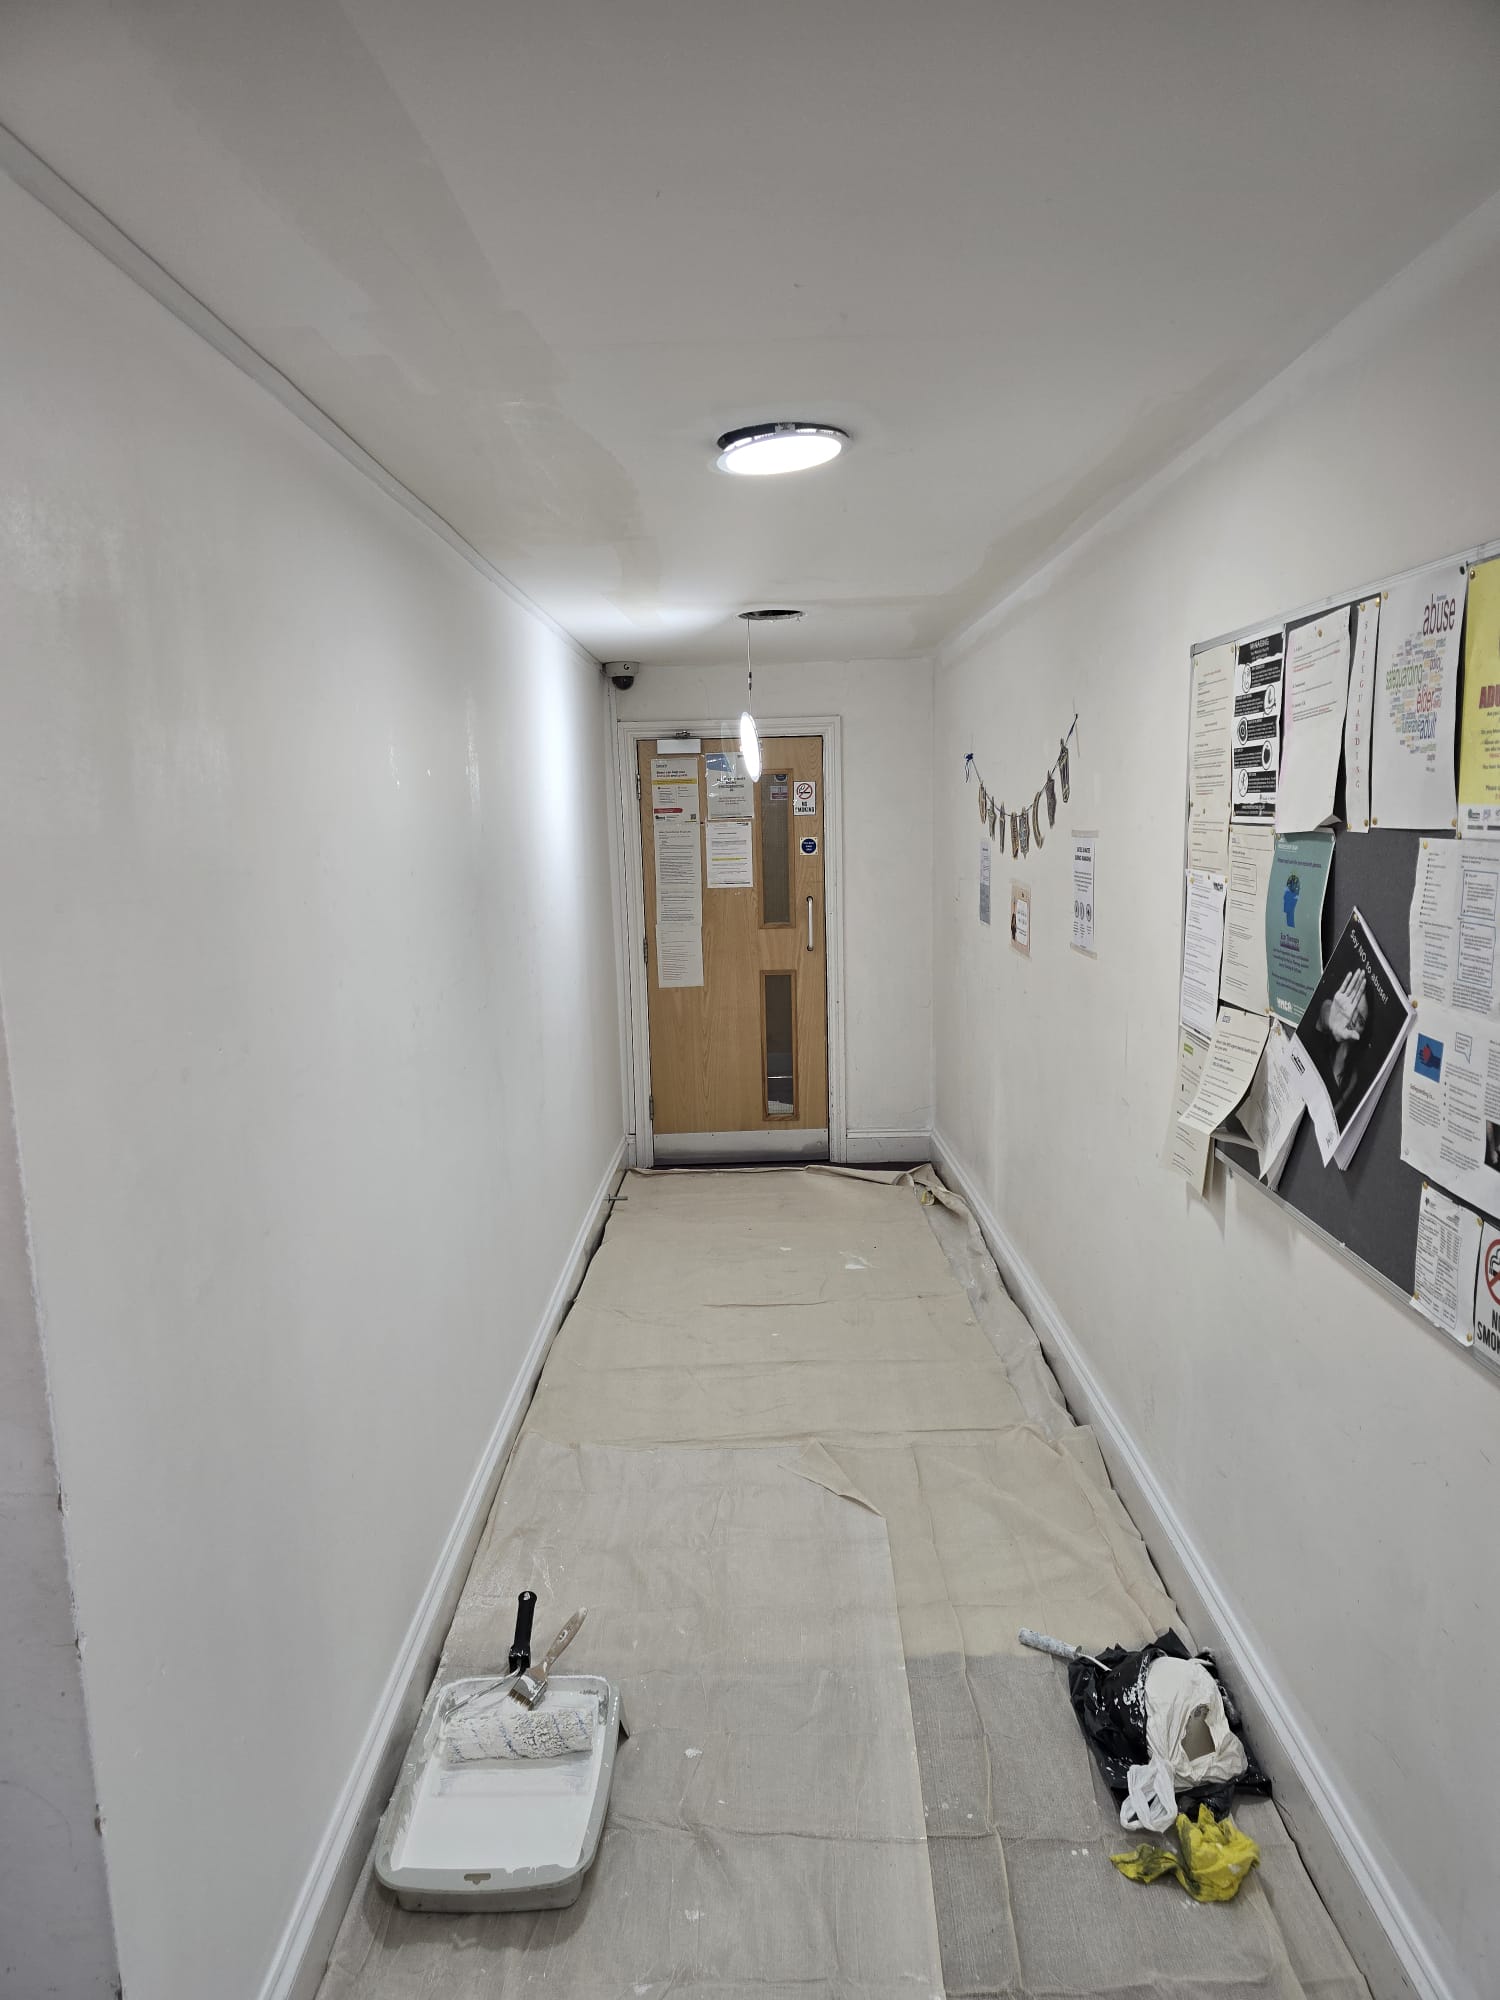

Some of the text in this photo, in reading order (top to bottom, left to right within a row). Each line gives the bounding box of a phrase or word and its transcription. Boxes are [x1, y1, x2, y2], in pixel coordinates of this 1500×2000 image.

[1423, 593, 1456, 636] abuse
[1386, 662, 1423, 695] safeguarding
[1416, 687, 1435, 713] elder
[1419, 711, 1437, 740] adult
[1350, 929, 1389, 1005] Say NO to abuse!
